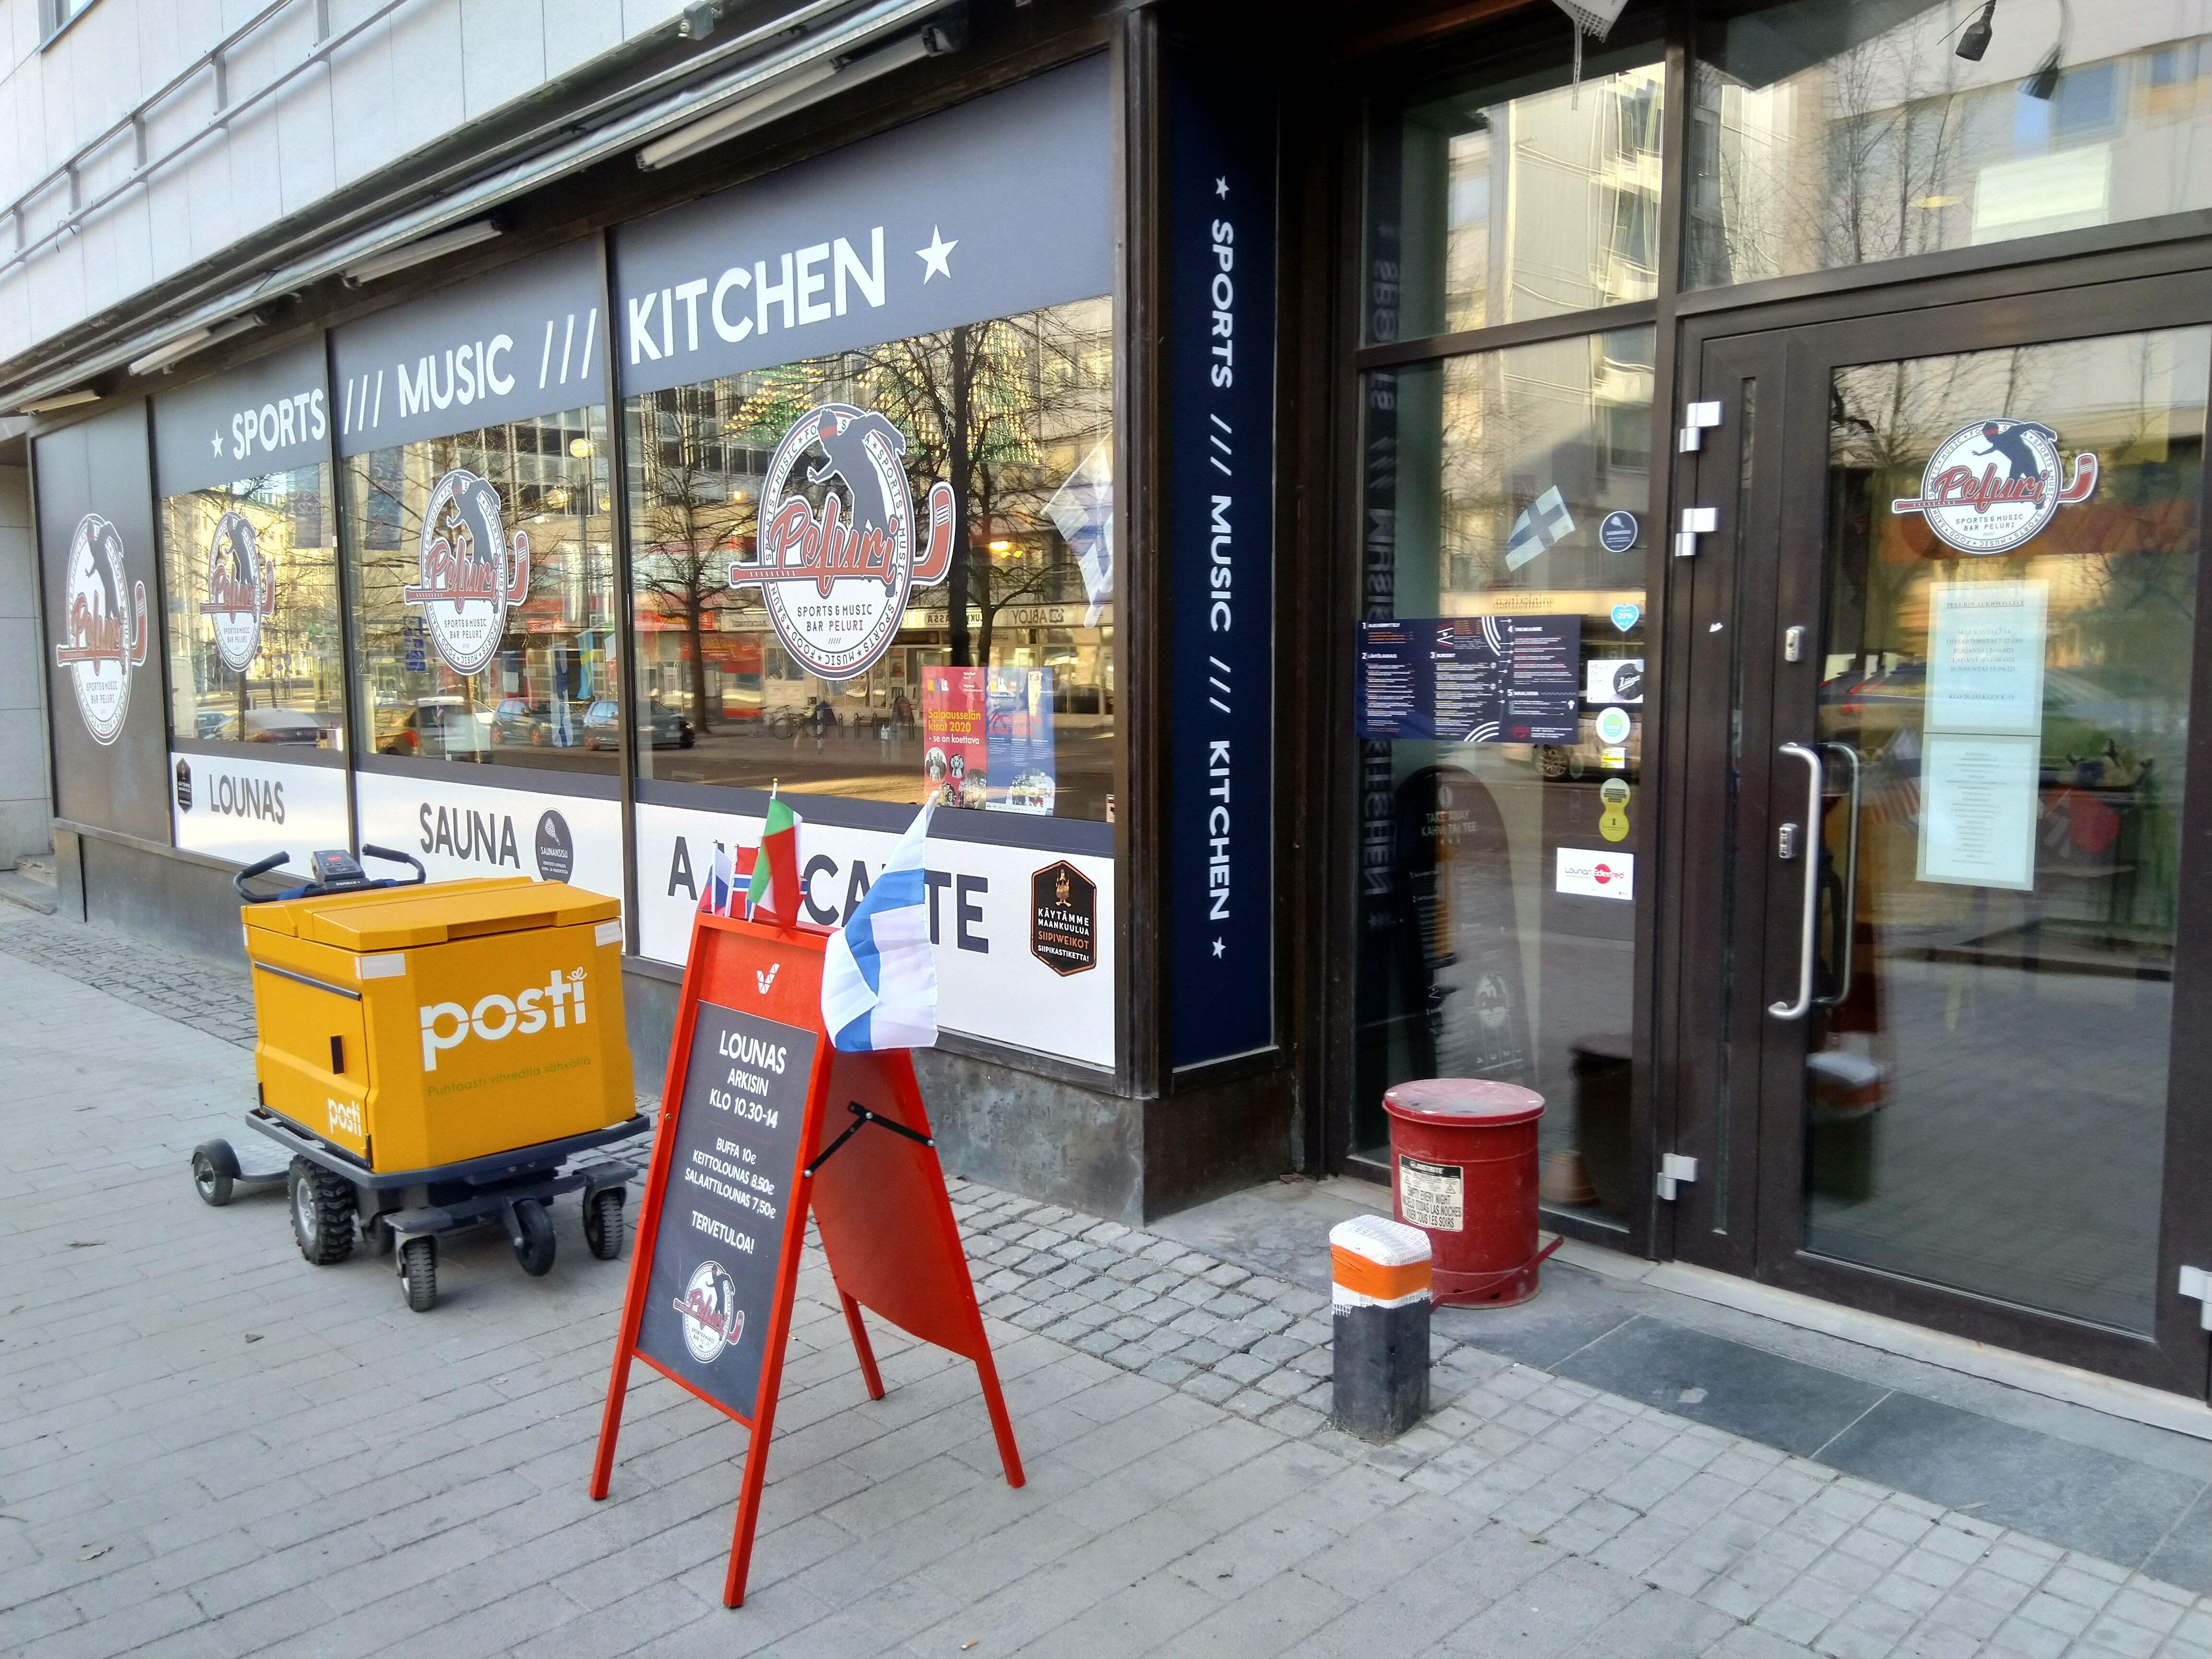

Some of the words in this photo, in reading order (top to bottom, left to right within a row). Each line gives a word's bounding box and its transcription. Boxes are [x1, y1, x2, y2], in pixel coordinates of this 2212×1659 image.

[1211, 218, 1234, 388] SPORTS
[232, 388, 325, 461] SPORTS
[398, 334, 517, 419] MUSIC
[629, 227, 886, 366] KITCHEN
[775, 444, 797, 485] MUSIC
[1933, 463, 2050, 513] Peluri
[1932, 509, 1946, 529] SAUN
[1984, 522, 2015, 530] PELURI
[769, 495, 899, 599] Peluri
[1210, 495, 1232, 632] MUSIC
[426, 536, 500, 614] Peluri
[770, 581, 787, 622] SAUN
[450, 630, 460, 640] BAR
[462, 630, 482, 639] PELURI
[806, 621, 824, 632] BAR
[829, 620, 864, 631] PELURI
[90, 694, 99, 704] BAR
[100, 694, 116, 704] PELURI
[928, 708, 981, 722] Salpausselän
[928, 719, 948, 732] kisat
[950, 721, 972, 733] 2020
[951, 733, 980, 745] koettava
[209, 774, 286, 825] LOUNAS
[420, 802, 521, 869] SAUNA
[1209, 740, 1230, 920] KITCHEN
[541, 846, 568, 859] SAUNANSISU
[668, 836, 697, 901] A
[802, 854, 989, 954] CATE
[1037, 907, 1090, 926] KÄYTÄMME
[1037, 918, 1090, 936] MAANKUULUA
[1037, 930, 1090, 950] SIIPIWEIKOT
[1037, 945, 1090, 962] SIIPIKASTIKETTA!
[421, 966, 588, 1071] posti
[719, 1029, 787, 1075] LOUNAS
[427, 1077, 486, 1097] Puhtaasti
[489, 1064, 541, 1086] vihreällä
[544, 1056, 591, 1075] sähköllä
[727, 1068, 769, 1097] ARKISIN
[328, 1097, 362, 1138] posti
[709, 1088, 731, 1111] KLO
[734, 1097, 779, 1129] 10.30-14
[693, 1149, 750, 1185] KEITTOLOUNAS
[716, 1137, 740, 1159] BUFFA
[743, 1147, 757, 1165] 10€
[685, 1167, 750, 1208] SALAATTILOUNAS
[752, 1197, 776, 1219] 7,50€
[1430, 1203, 1440, 1215] LAS
[1440, 1205, 1462, 1217] NOCHES
[1435, 1194, 1451, 1205] NIGHT
[692, 1210, 756, 1254] TERVETULOA!
[1439, 1216, 1455, 1228] SOIRS
